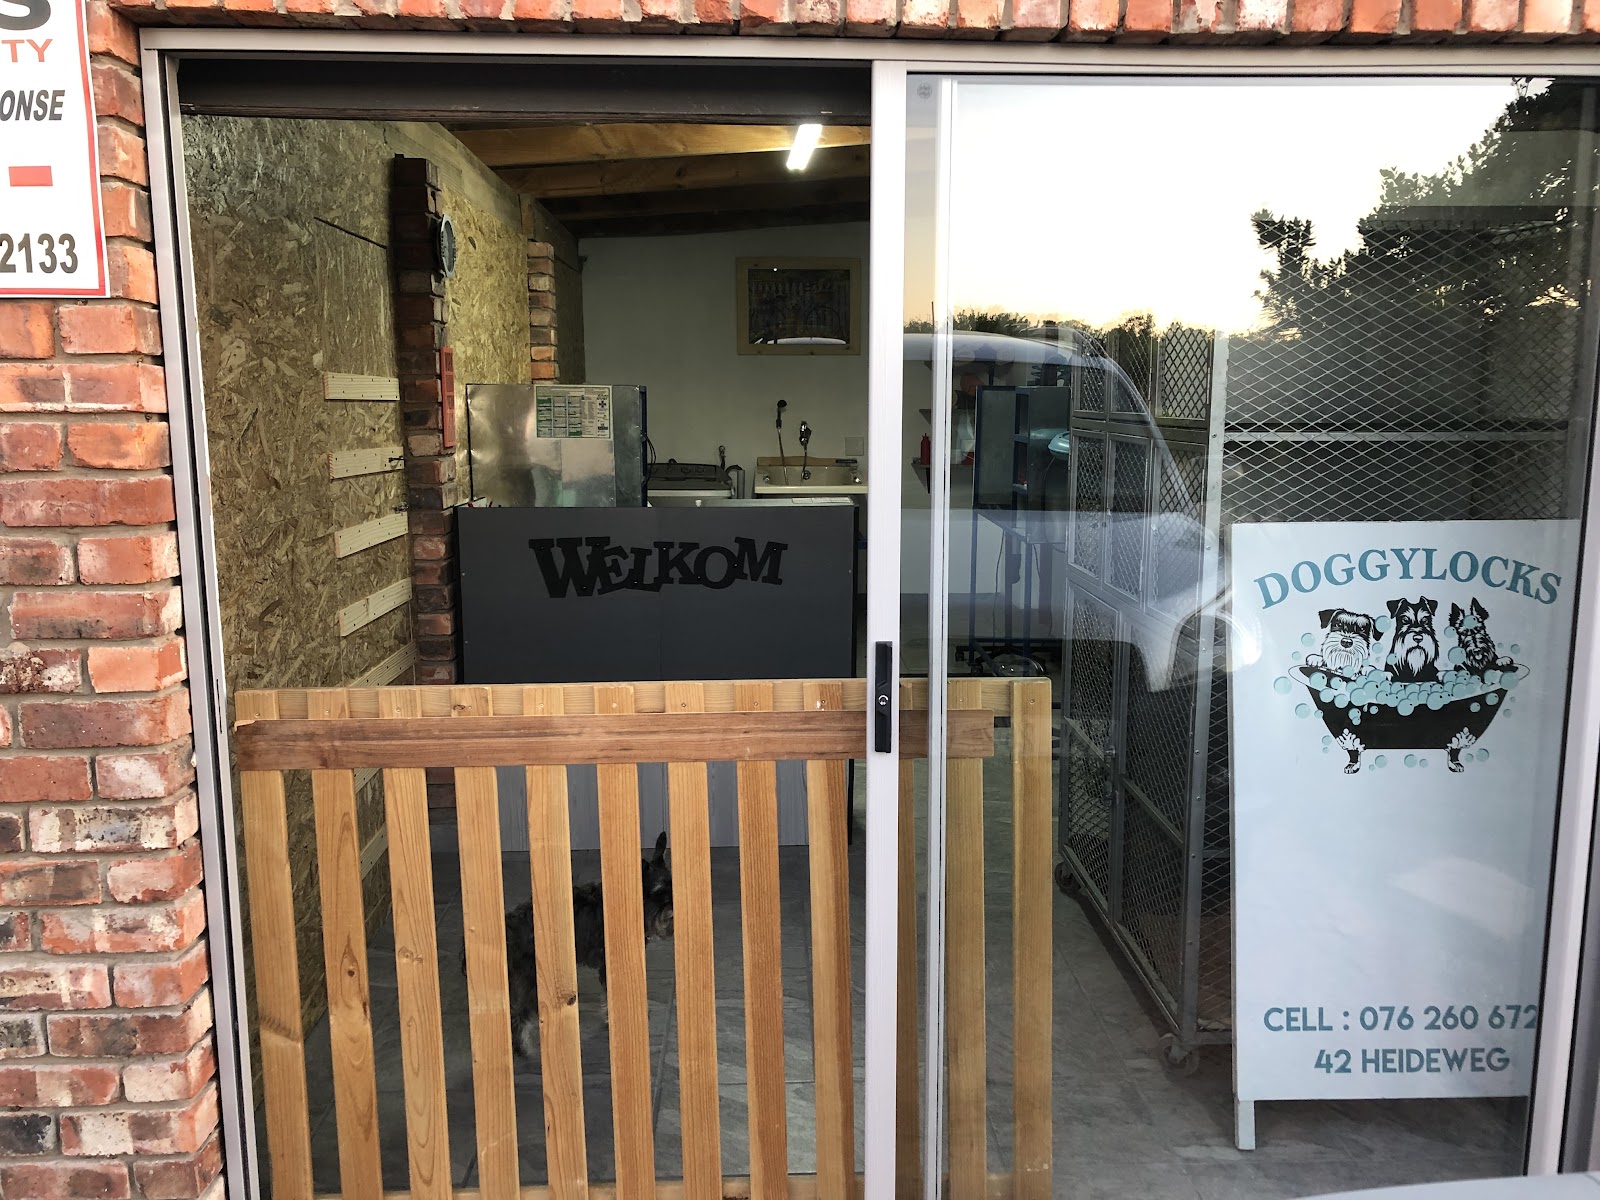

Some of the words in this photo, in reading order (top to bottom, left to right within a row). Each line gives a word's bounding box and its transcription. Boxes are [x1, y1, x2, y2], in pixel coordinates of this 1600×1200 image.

[528, 536, 789, 599] WELKOM
[1253, 547, 1562, 609] DOGGYLOCKS
[1263, 1006, 1333, 1032] CELL
[1359, 1005, 1415, 1031] 076
[1423, 1004, 1480, 1031] 260
[1314, 1049, 1352, 1074] 42
[1361, 1047, 1511, 1073] HEIDEWEG
